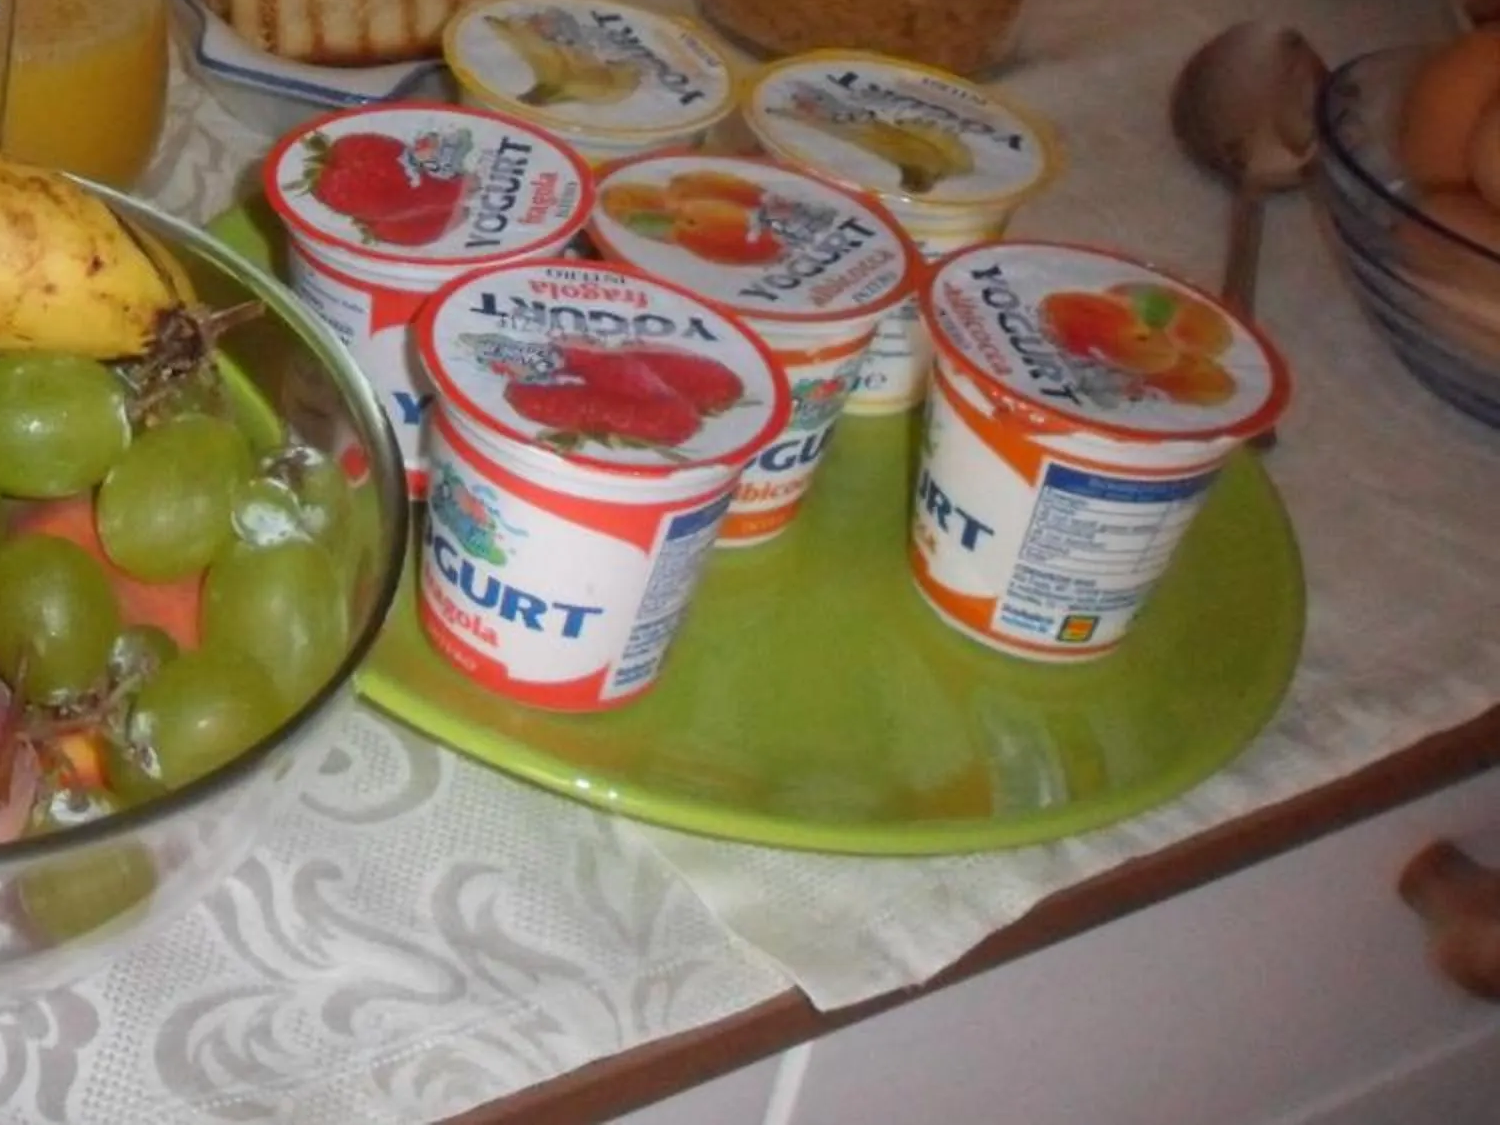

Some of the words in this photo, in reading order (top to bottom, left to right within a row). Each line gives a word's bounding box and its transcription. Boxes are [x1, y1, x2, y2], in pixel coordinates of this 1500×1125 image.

[464, 136, 532, 248] YOGURT
[738, 216, 877, 302] YOGURT
[469, 293, 719, 341] YOGURT
[971, 264, 1082, 407] YOGURT
